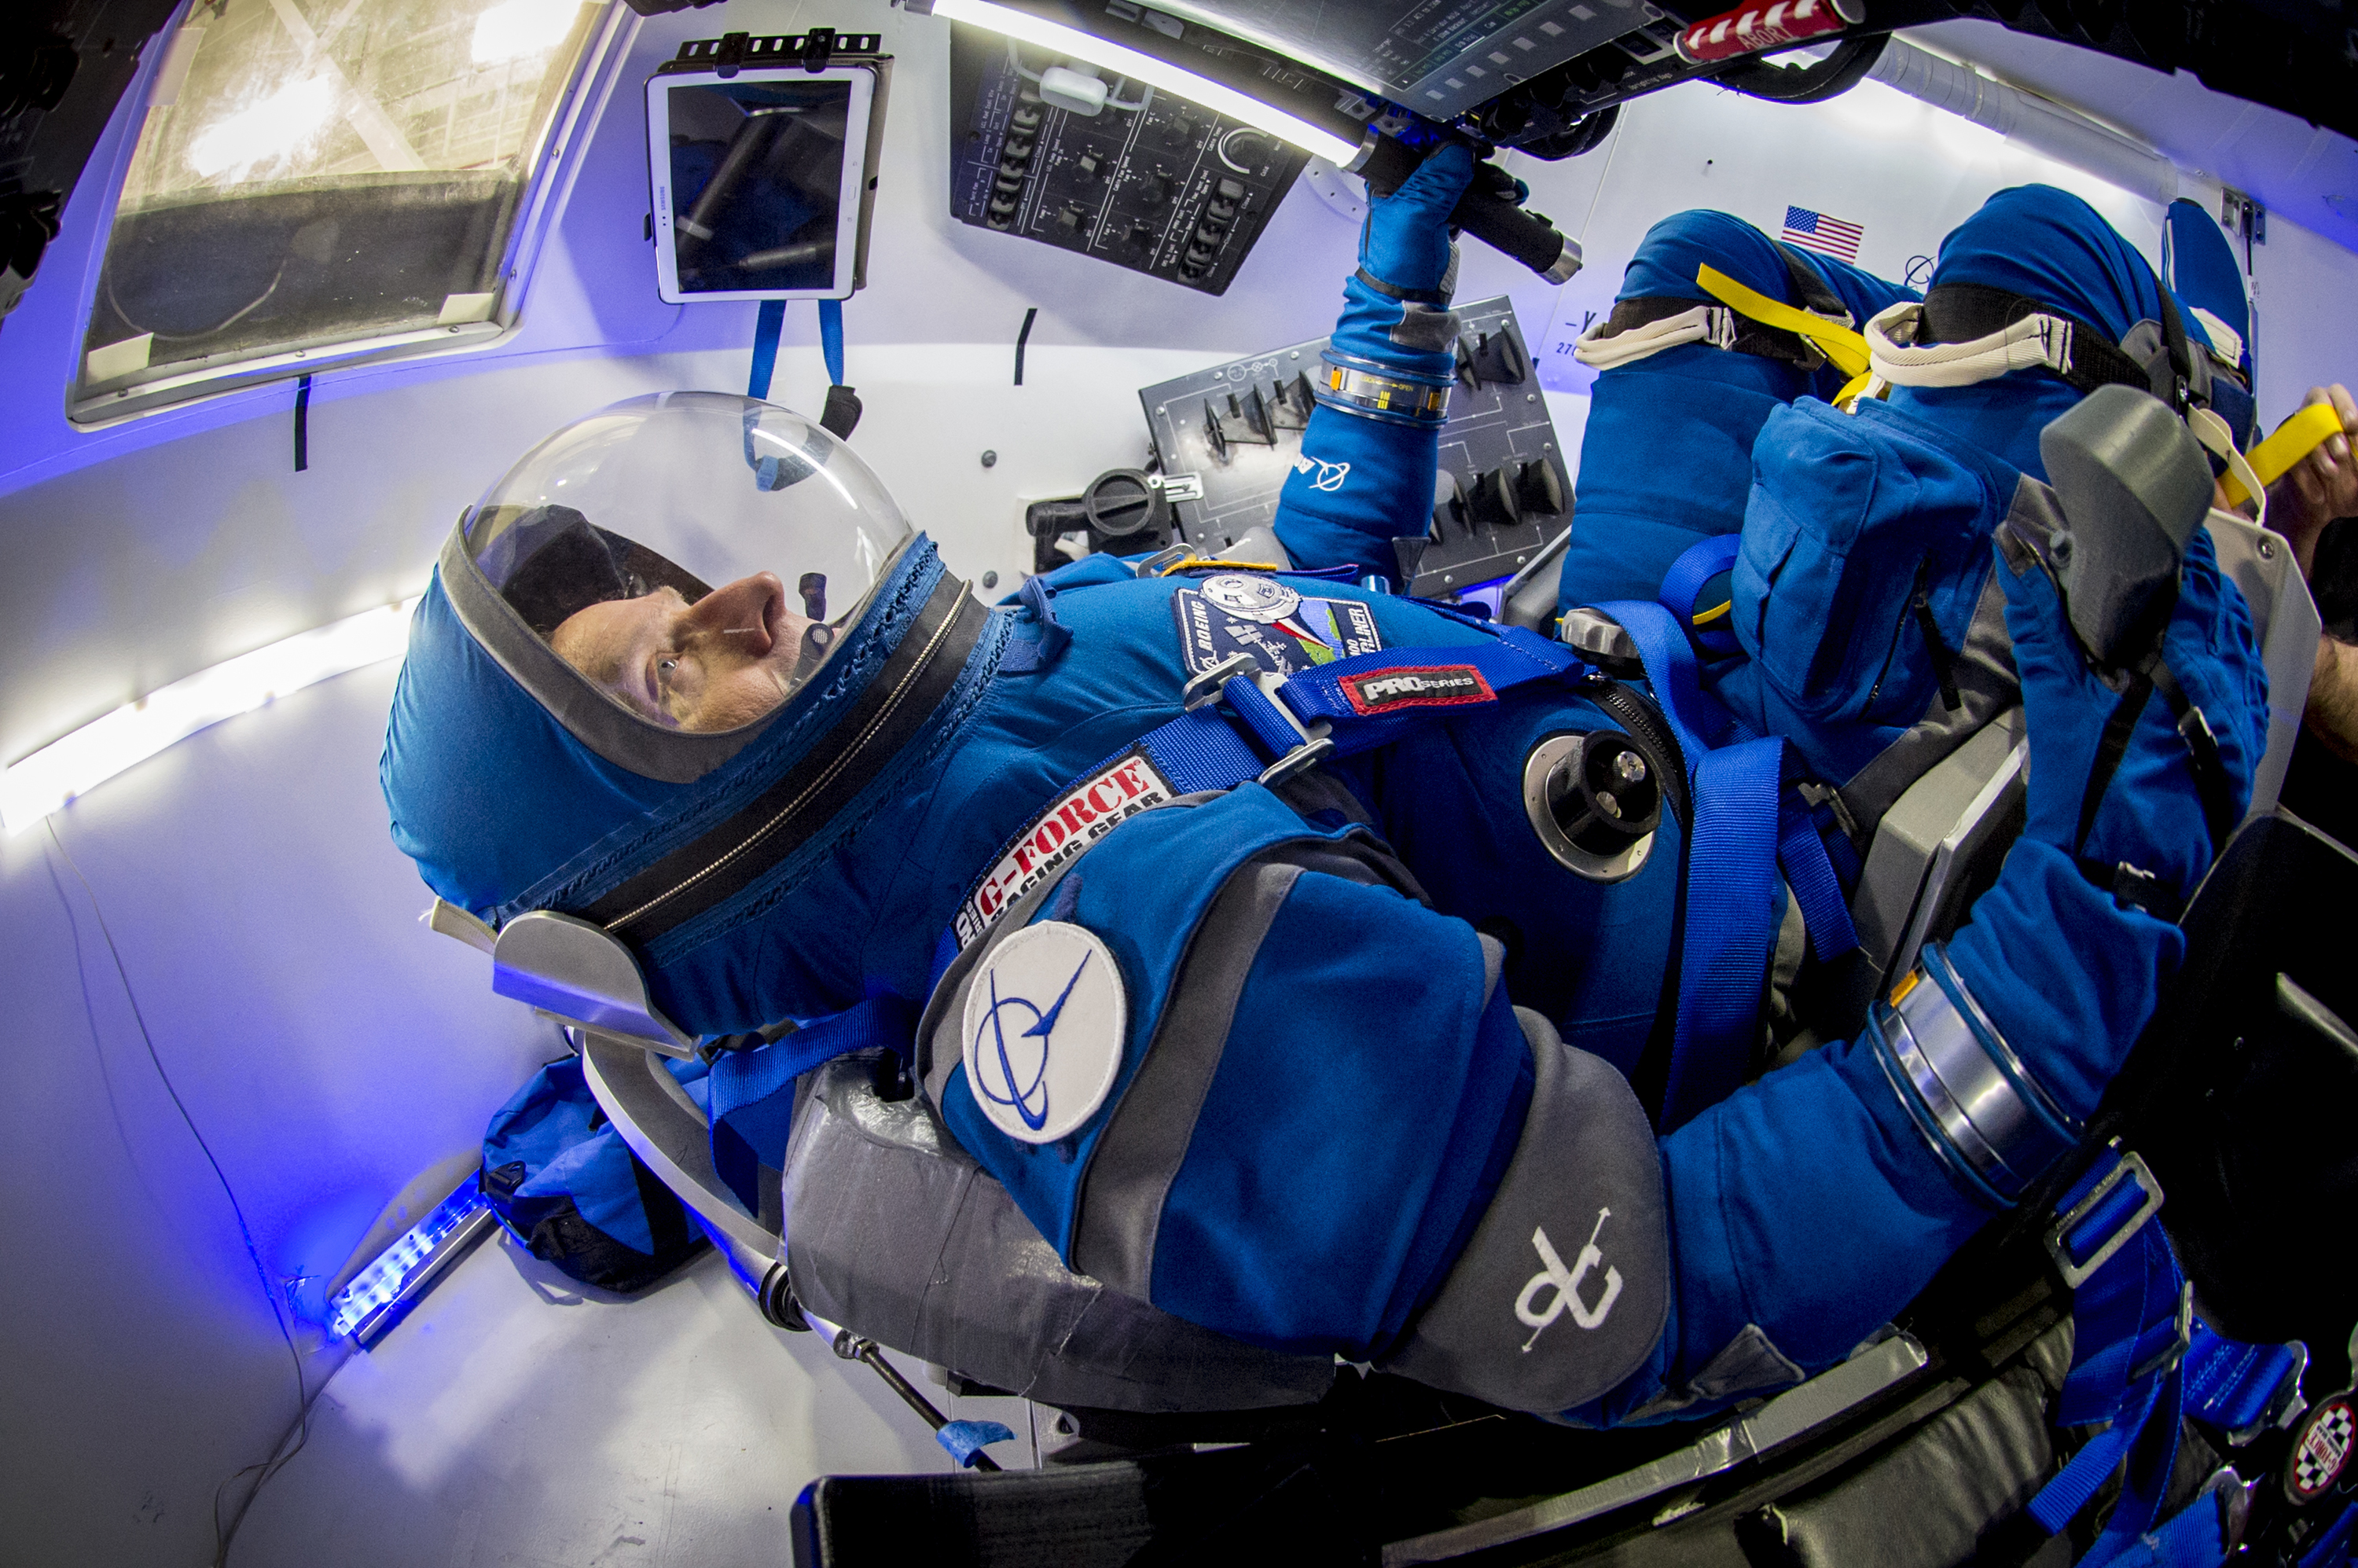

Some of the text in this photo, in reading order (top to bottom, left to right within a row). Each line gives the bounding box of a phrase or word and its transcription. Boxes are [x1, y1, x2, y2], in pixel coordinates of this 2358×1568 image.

[1738, 26, 1794, 50] ABORT
[1206, 138, 1217, 152] Cabin
[1360, 374, 1413, 392] LOCK OPEN
[1191, 600, 1214, 652] BOEING
[1348, 608, 1376, 654] RLINER
[1346, 638, 1363, 657] 100
[1364, 677, 1474, 700] PRO SERIES
[1088, 791, 1164, 839] GEAR
